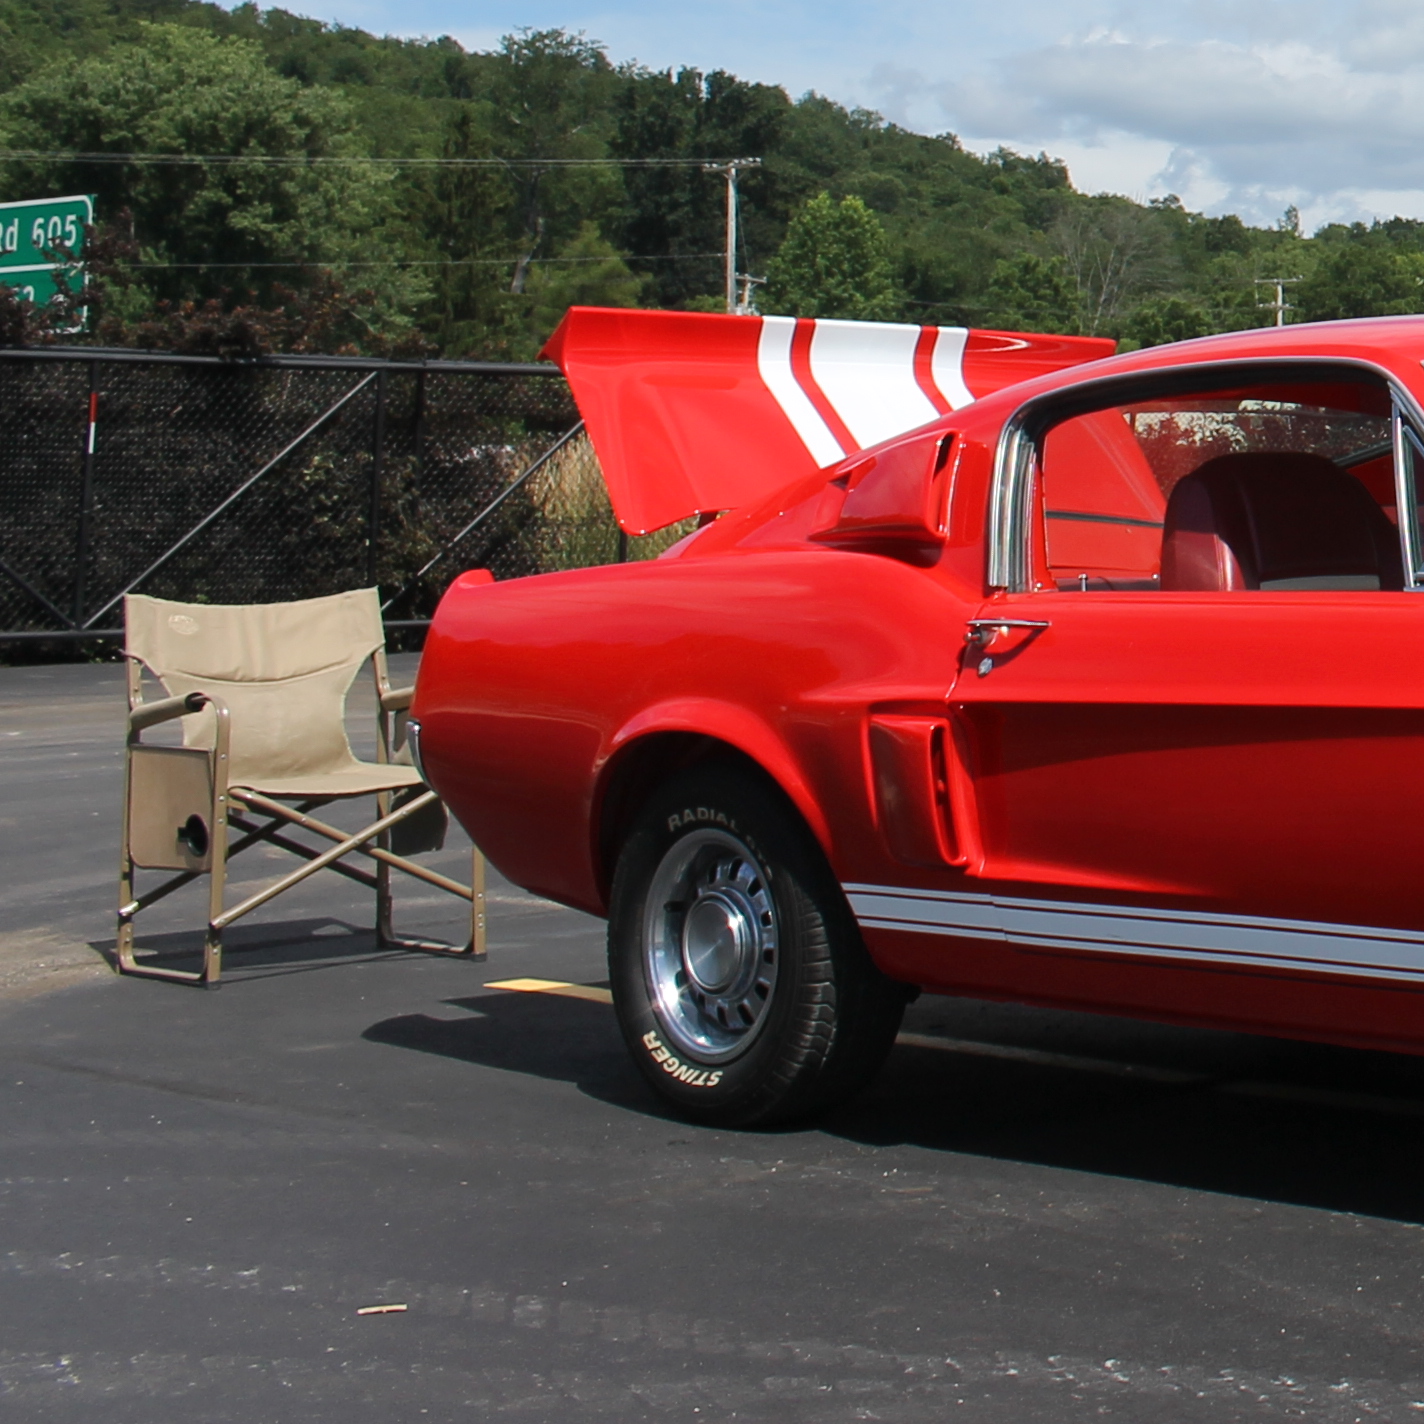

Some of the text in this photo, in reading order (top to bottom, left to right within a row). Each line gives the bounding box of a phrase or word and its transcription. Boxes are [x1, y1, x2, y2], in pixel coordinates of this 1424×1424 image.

[32, 214, 78, 249] 605
[667, 806, 740, 833] RADIAL
[641, 1029, 723, 1088] STINGER
